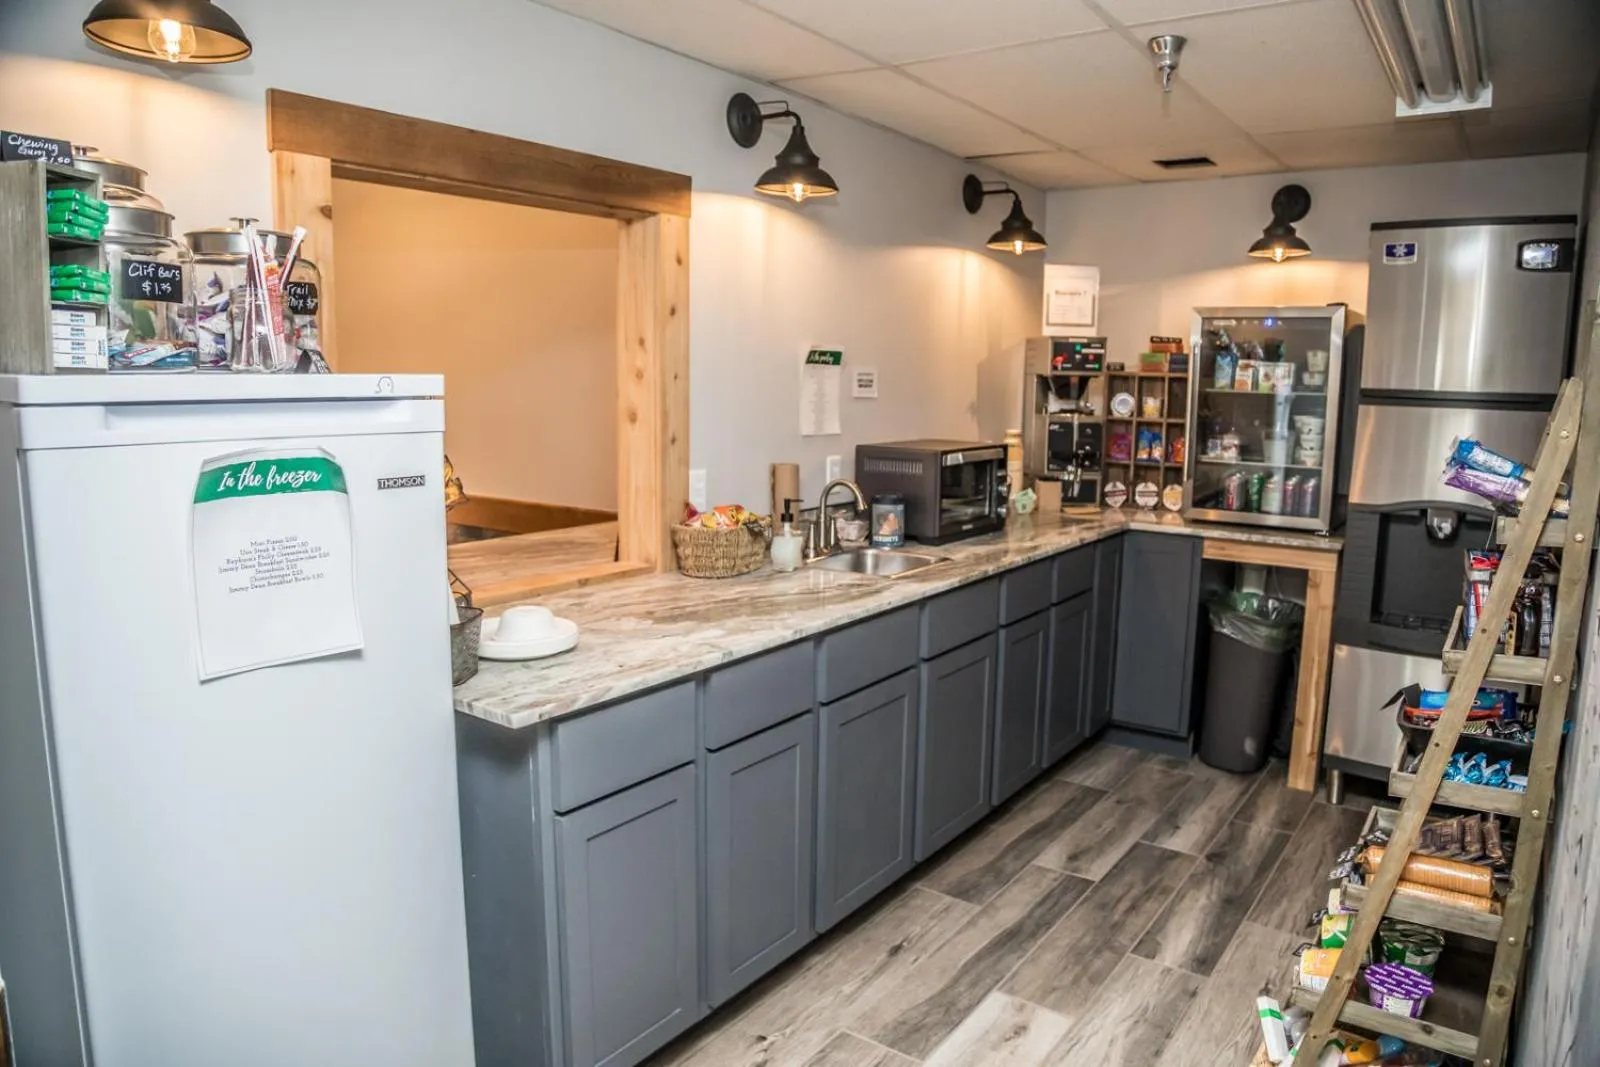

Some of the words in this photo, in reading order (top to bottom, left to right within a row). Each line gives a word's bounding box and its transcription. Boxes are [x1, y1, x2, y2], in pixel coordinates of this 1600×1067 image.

[8, 134, 58, 156] Chewing
[128, 263, 156, 277] Clif
[158, 267, 180, 281] Bars
[217, 471, 235, 492] In
[238, 462, 264, 490] the
[266, 465, 322, 490] freezer
[379, 477, 425, 488] THOMSON
